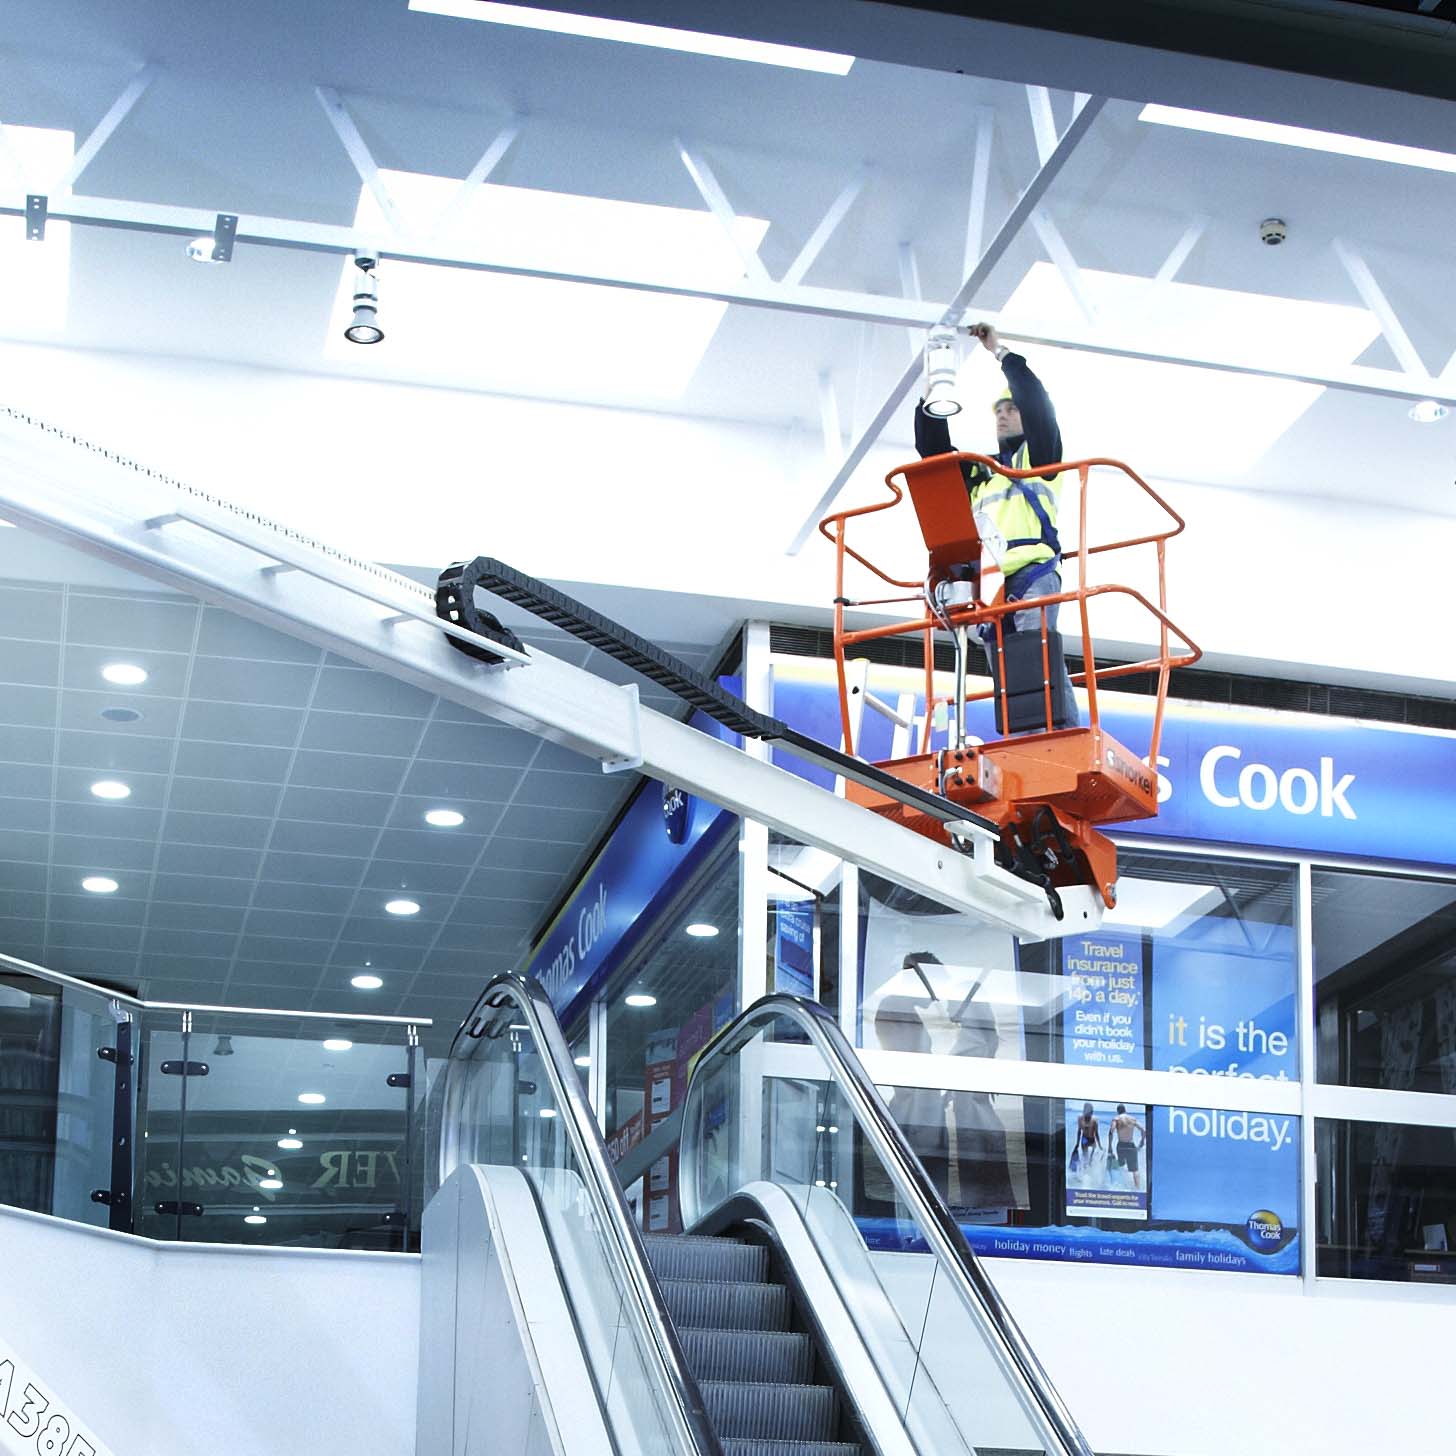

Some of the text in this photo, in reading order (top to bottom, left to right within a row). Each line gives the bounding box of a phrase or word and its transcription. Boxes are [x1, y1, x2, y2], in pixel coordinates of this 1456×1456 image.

[1199, 745, 1356, 820] Cook
[535, 883, 607, 1000] omas Cook
[1081, 941, 1124, 958] Travel
[1067, 956, 1138, 974] insurance
[1072, 971, 1135, 990] from just
[1096, 991, 1106, 1002] a
[1075, 1010, 1132, 1027] Even if you
[1075, 1023, 1133, 1038] didn't book
[1168, 1013, 1288, 1056] it is the
[1072, 1038, 1136, 1053] your holiday
[1084, 1051, 1125, 1064] with us.
[1168, 1107, 1292, 1151] holiday.
[1249, 1220, 1281, 1232] Thomas
[1261, 1230, 1281, 1240] Cook
[995, 1239, 1030, 1256] holiday
[1033, 1243, 1066, 1256] money
[1069, 1247, 1093, 1258] flights
[1100, 1247, 1135, 1258] late deals
[1175, 1250, 1246, 1267] family holidays
